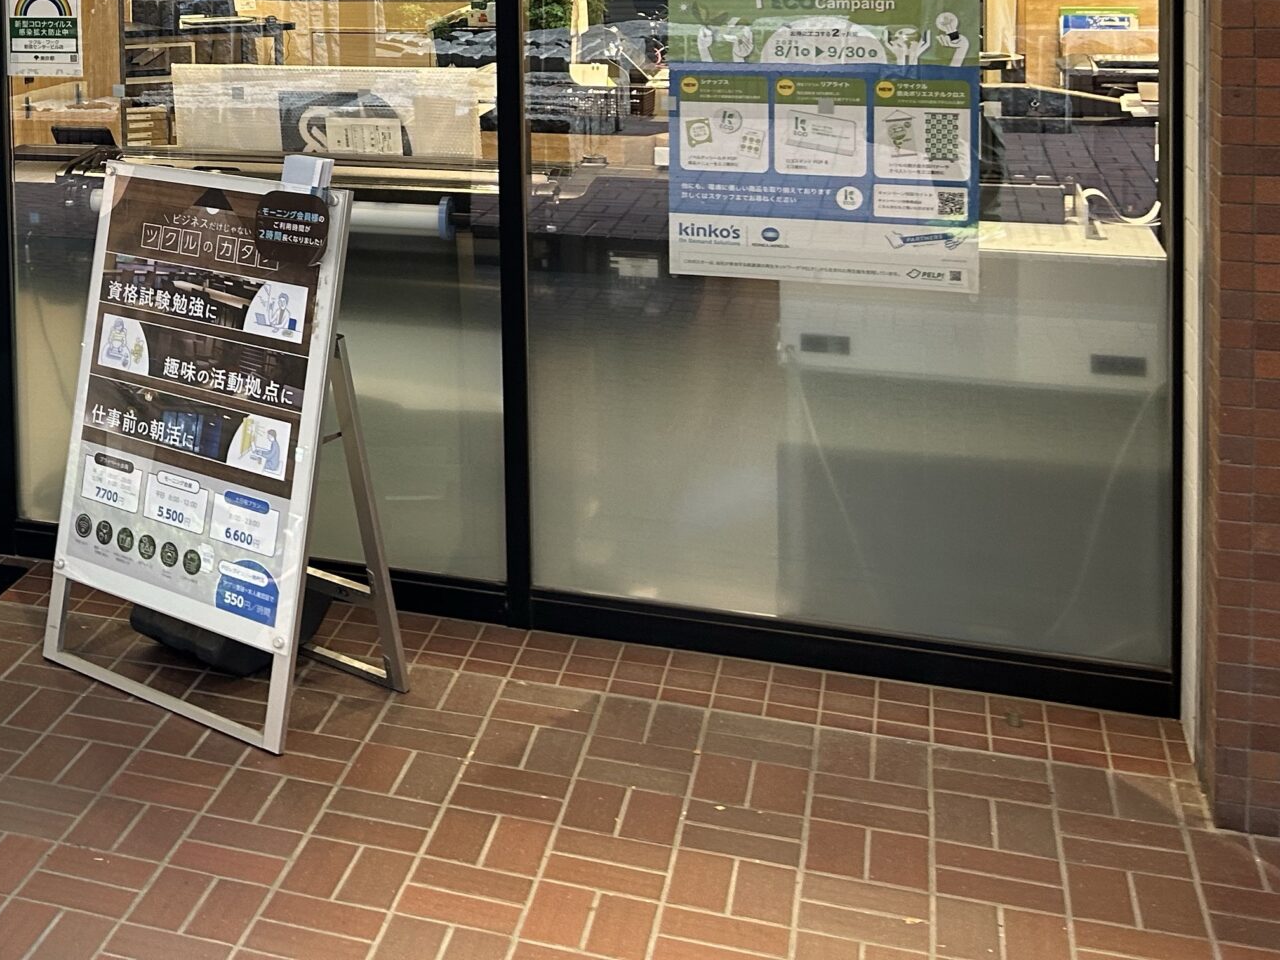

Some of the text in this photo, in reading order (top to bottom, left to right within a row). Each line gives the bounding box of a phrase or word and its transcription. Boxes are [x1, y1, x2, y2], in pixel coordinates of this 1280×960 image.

[14, 20, 72, 28] 新型コロナウイルス
[18, 28, 69, 36] 感染拡大防止中
[172, 214, 252, 236] ビジネスだけじゃない
[262, 207, 324, 223] モーニング会員様の
[273, 221, 311, 234] ご利用時間が
[678, 222, 740, 240] kinko's
[143, 226, 272, 265] ツクルのカタ
[107, 280, 218, 320] 資格試験勉強に
[163, 356, 294, 404] 趣味の活動拠点に
[92, 404, 194, 448] 仕事前の朝活に
